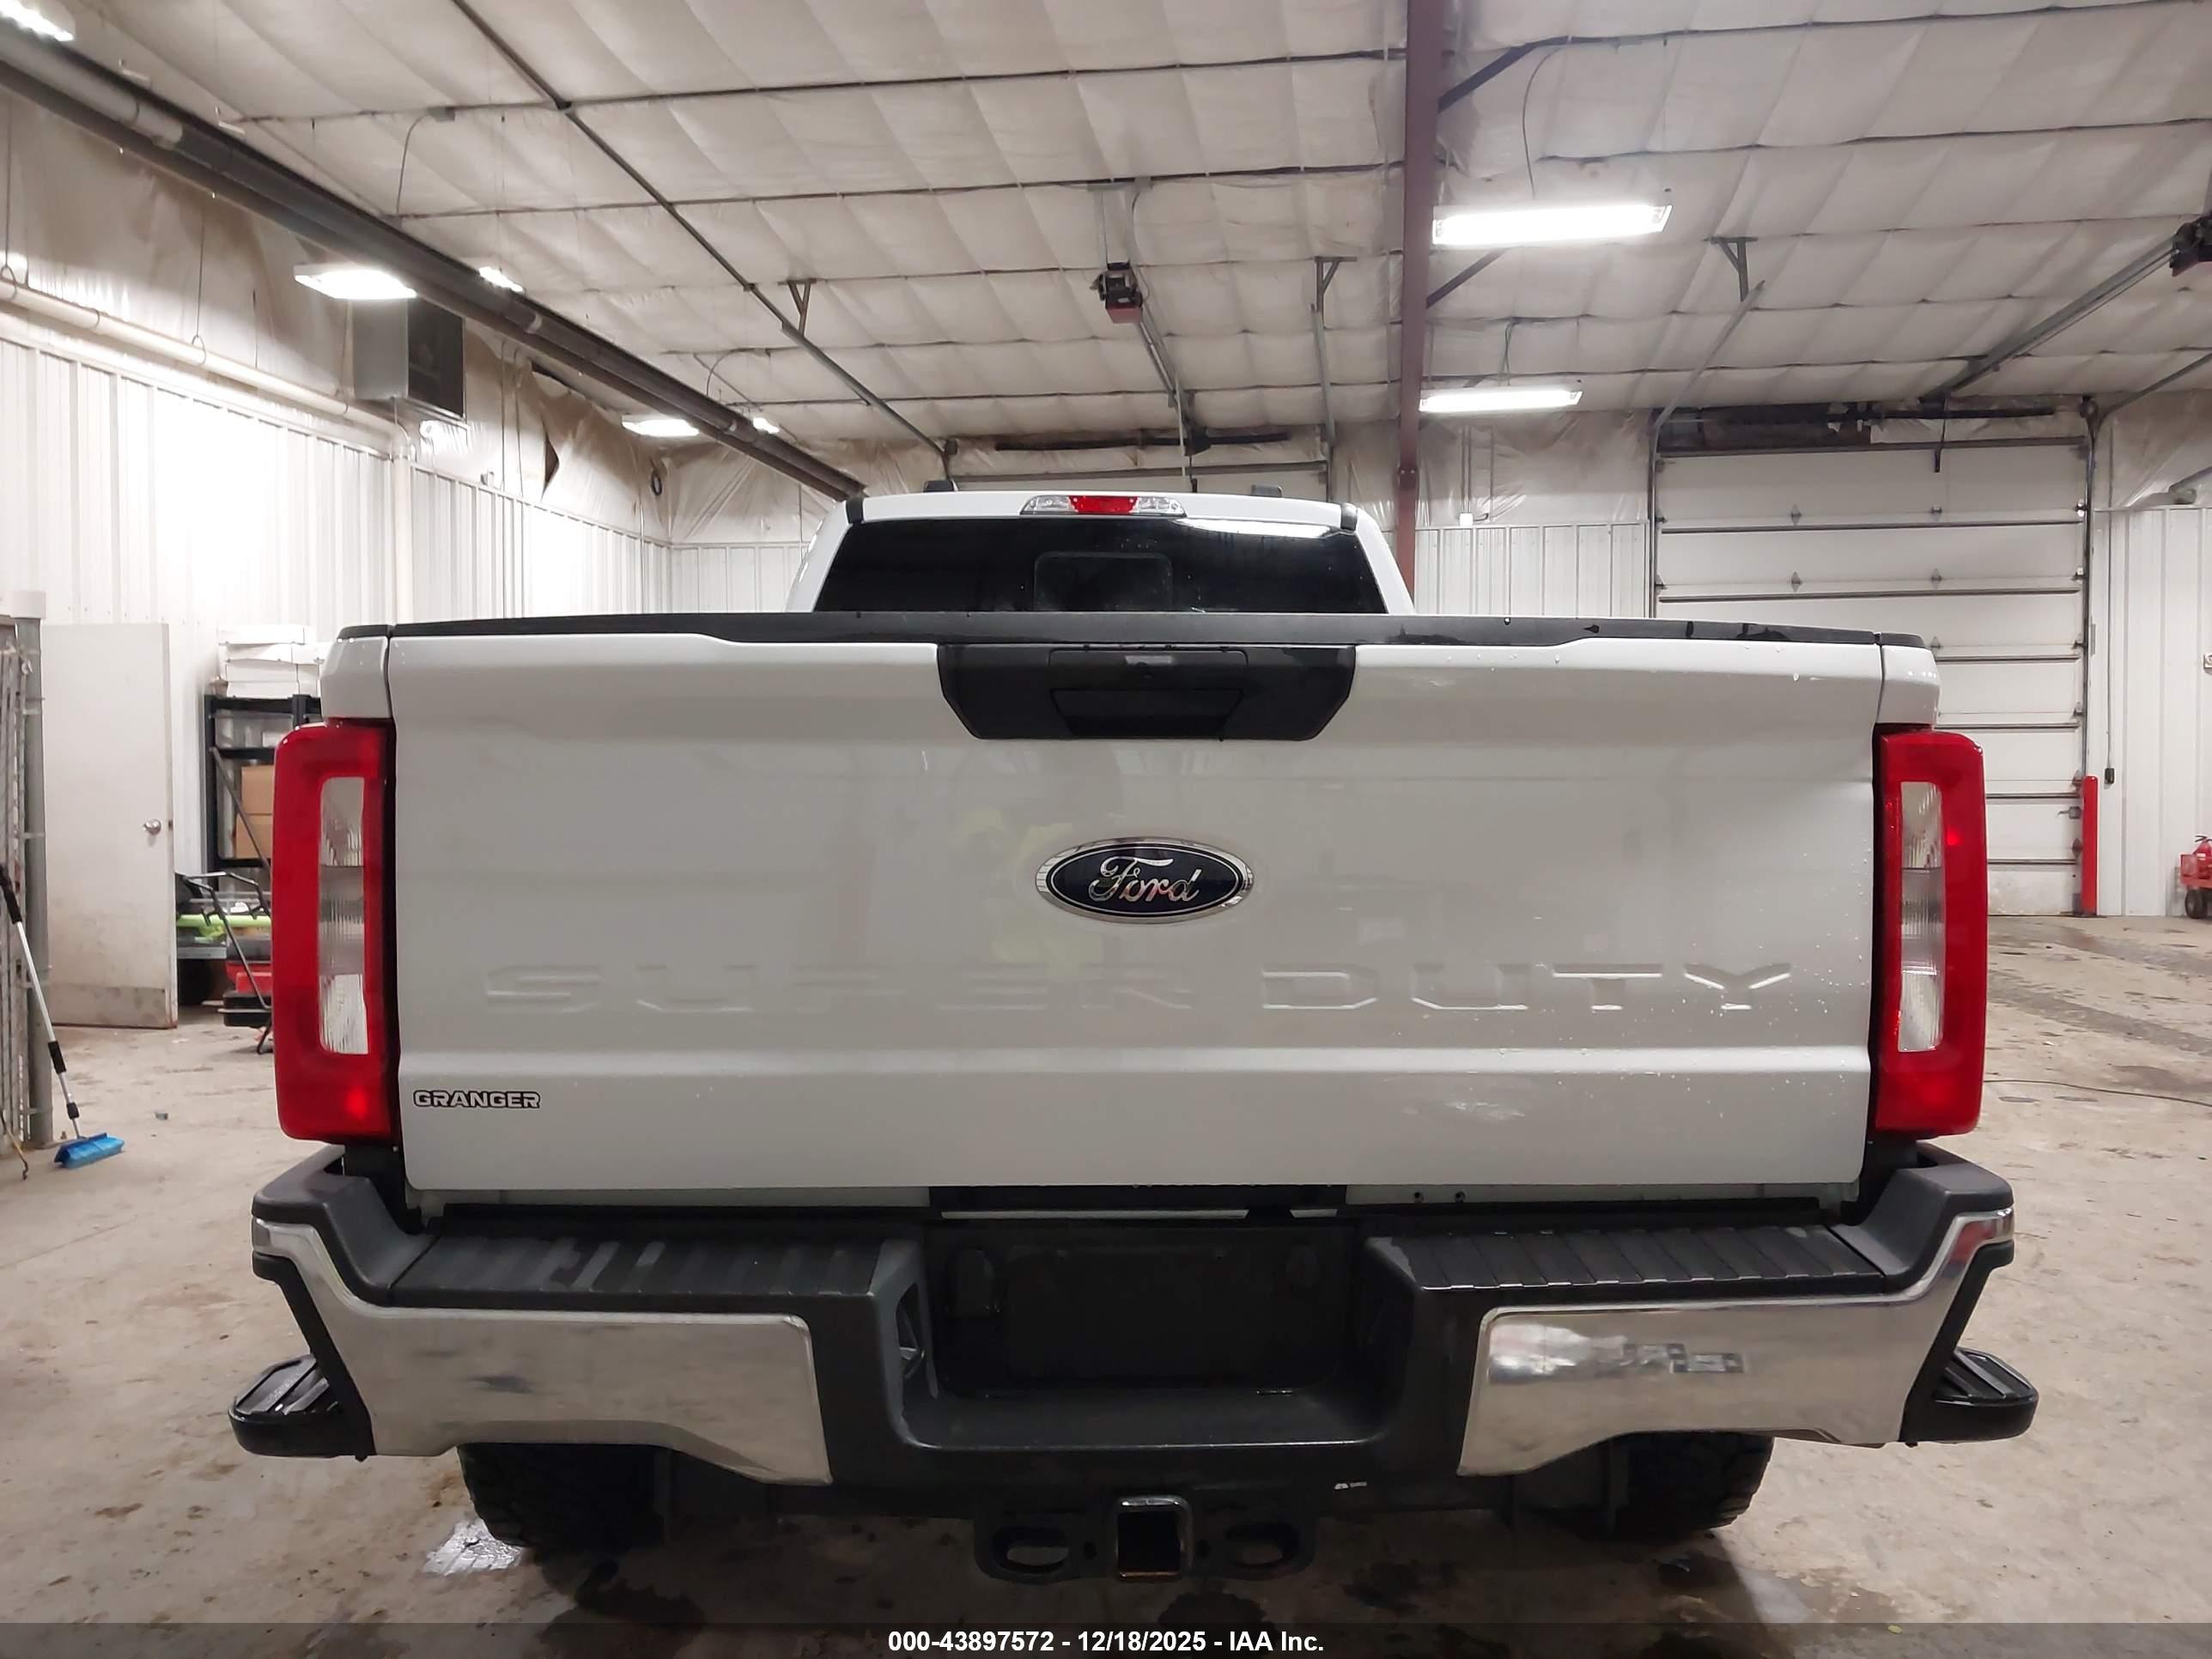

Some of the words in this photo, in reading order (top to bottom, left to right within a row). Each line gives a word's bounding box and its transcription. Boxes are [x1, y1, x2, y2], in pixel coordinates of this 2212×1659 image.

[1089, 857, 1200, 902] Ford
[484, 965, 1194, 1012] SUPER
[1262, 963, 1791, 1010] DUTY
[414, 1090, 541, 1109] GRANGER
